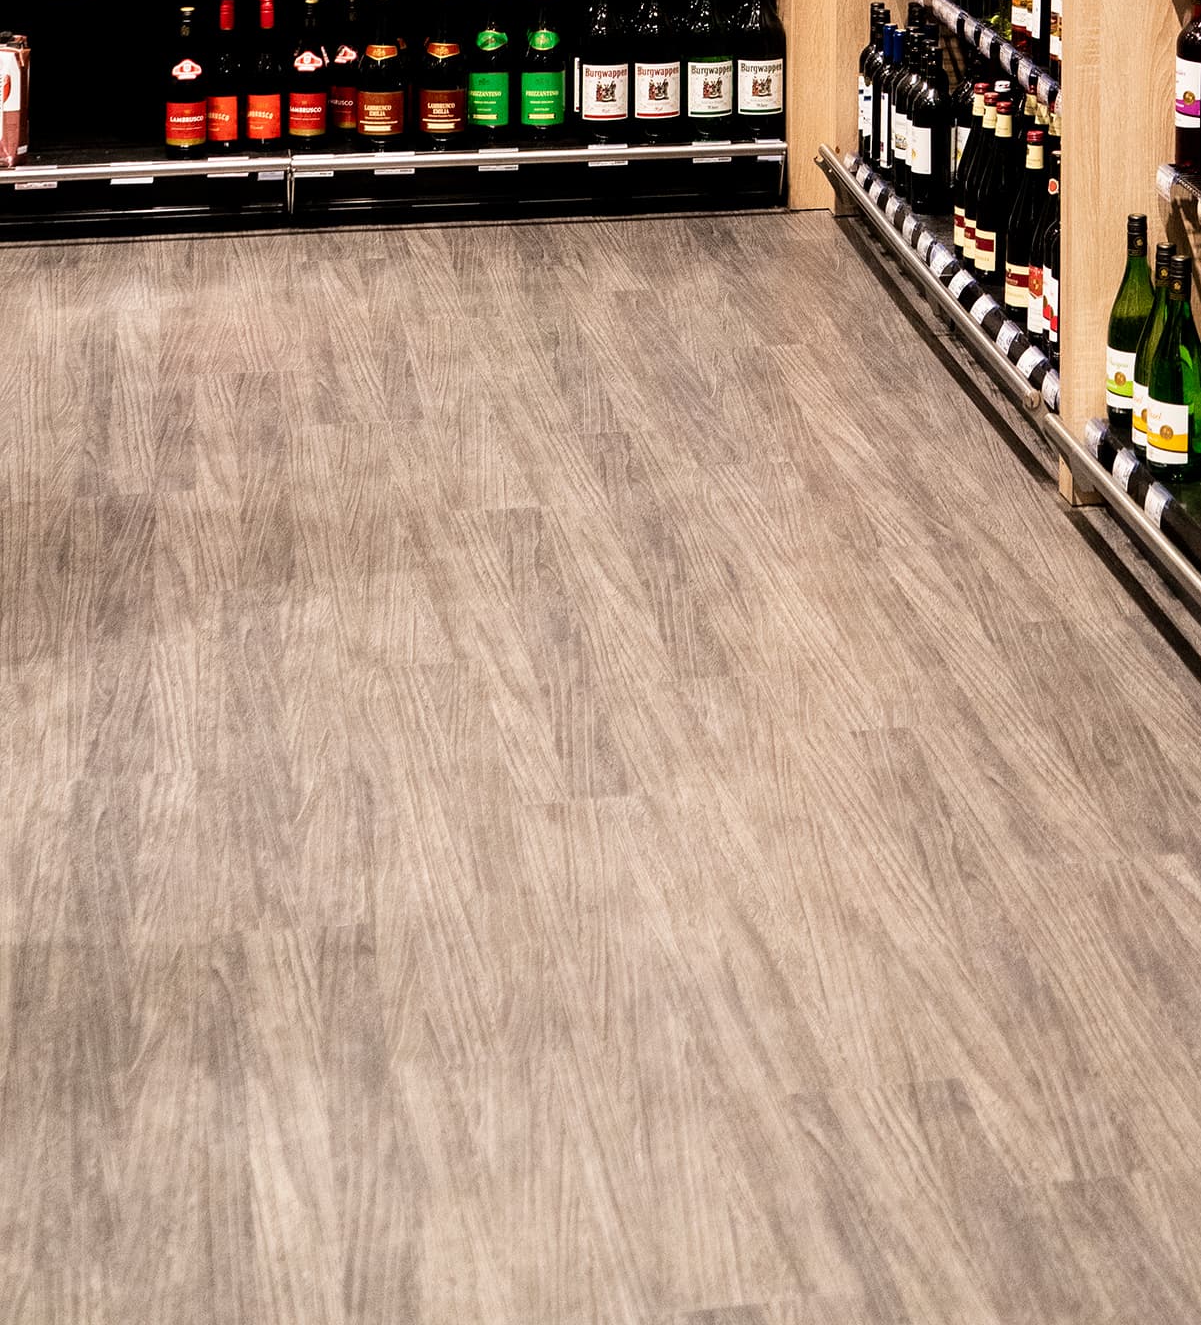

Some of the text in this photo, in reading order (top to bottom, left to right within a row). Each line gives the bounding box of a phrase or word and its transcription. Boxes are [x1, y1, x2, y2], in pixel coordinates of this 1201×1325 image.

[585, 67, 628, 79] Burgwappen
[637, 65, 679, 78] Burgwappen
[691, 64, 733, 77] Burgwappen
[740, 62, 782, 75] Burgwappen
[169, 115, 204, 123] LAMBRUSCO
